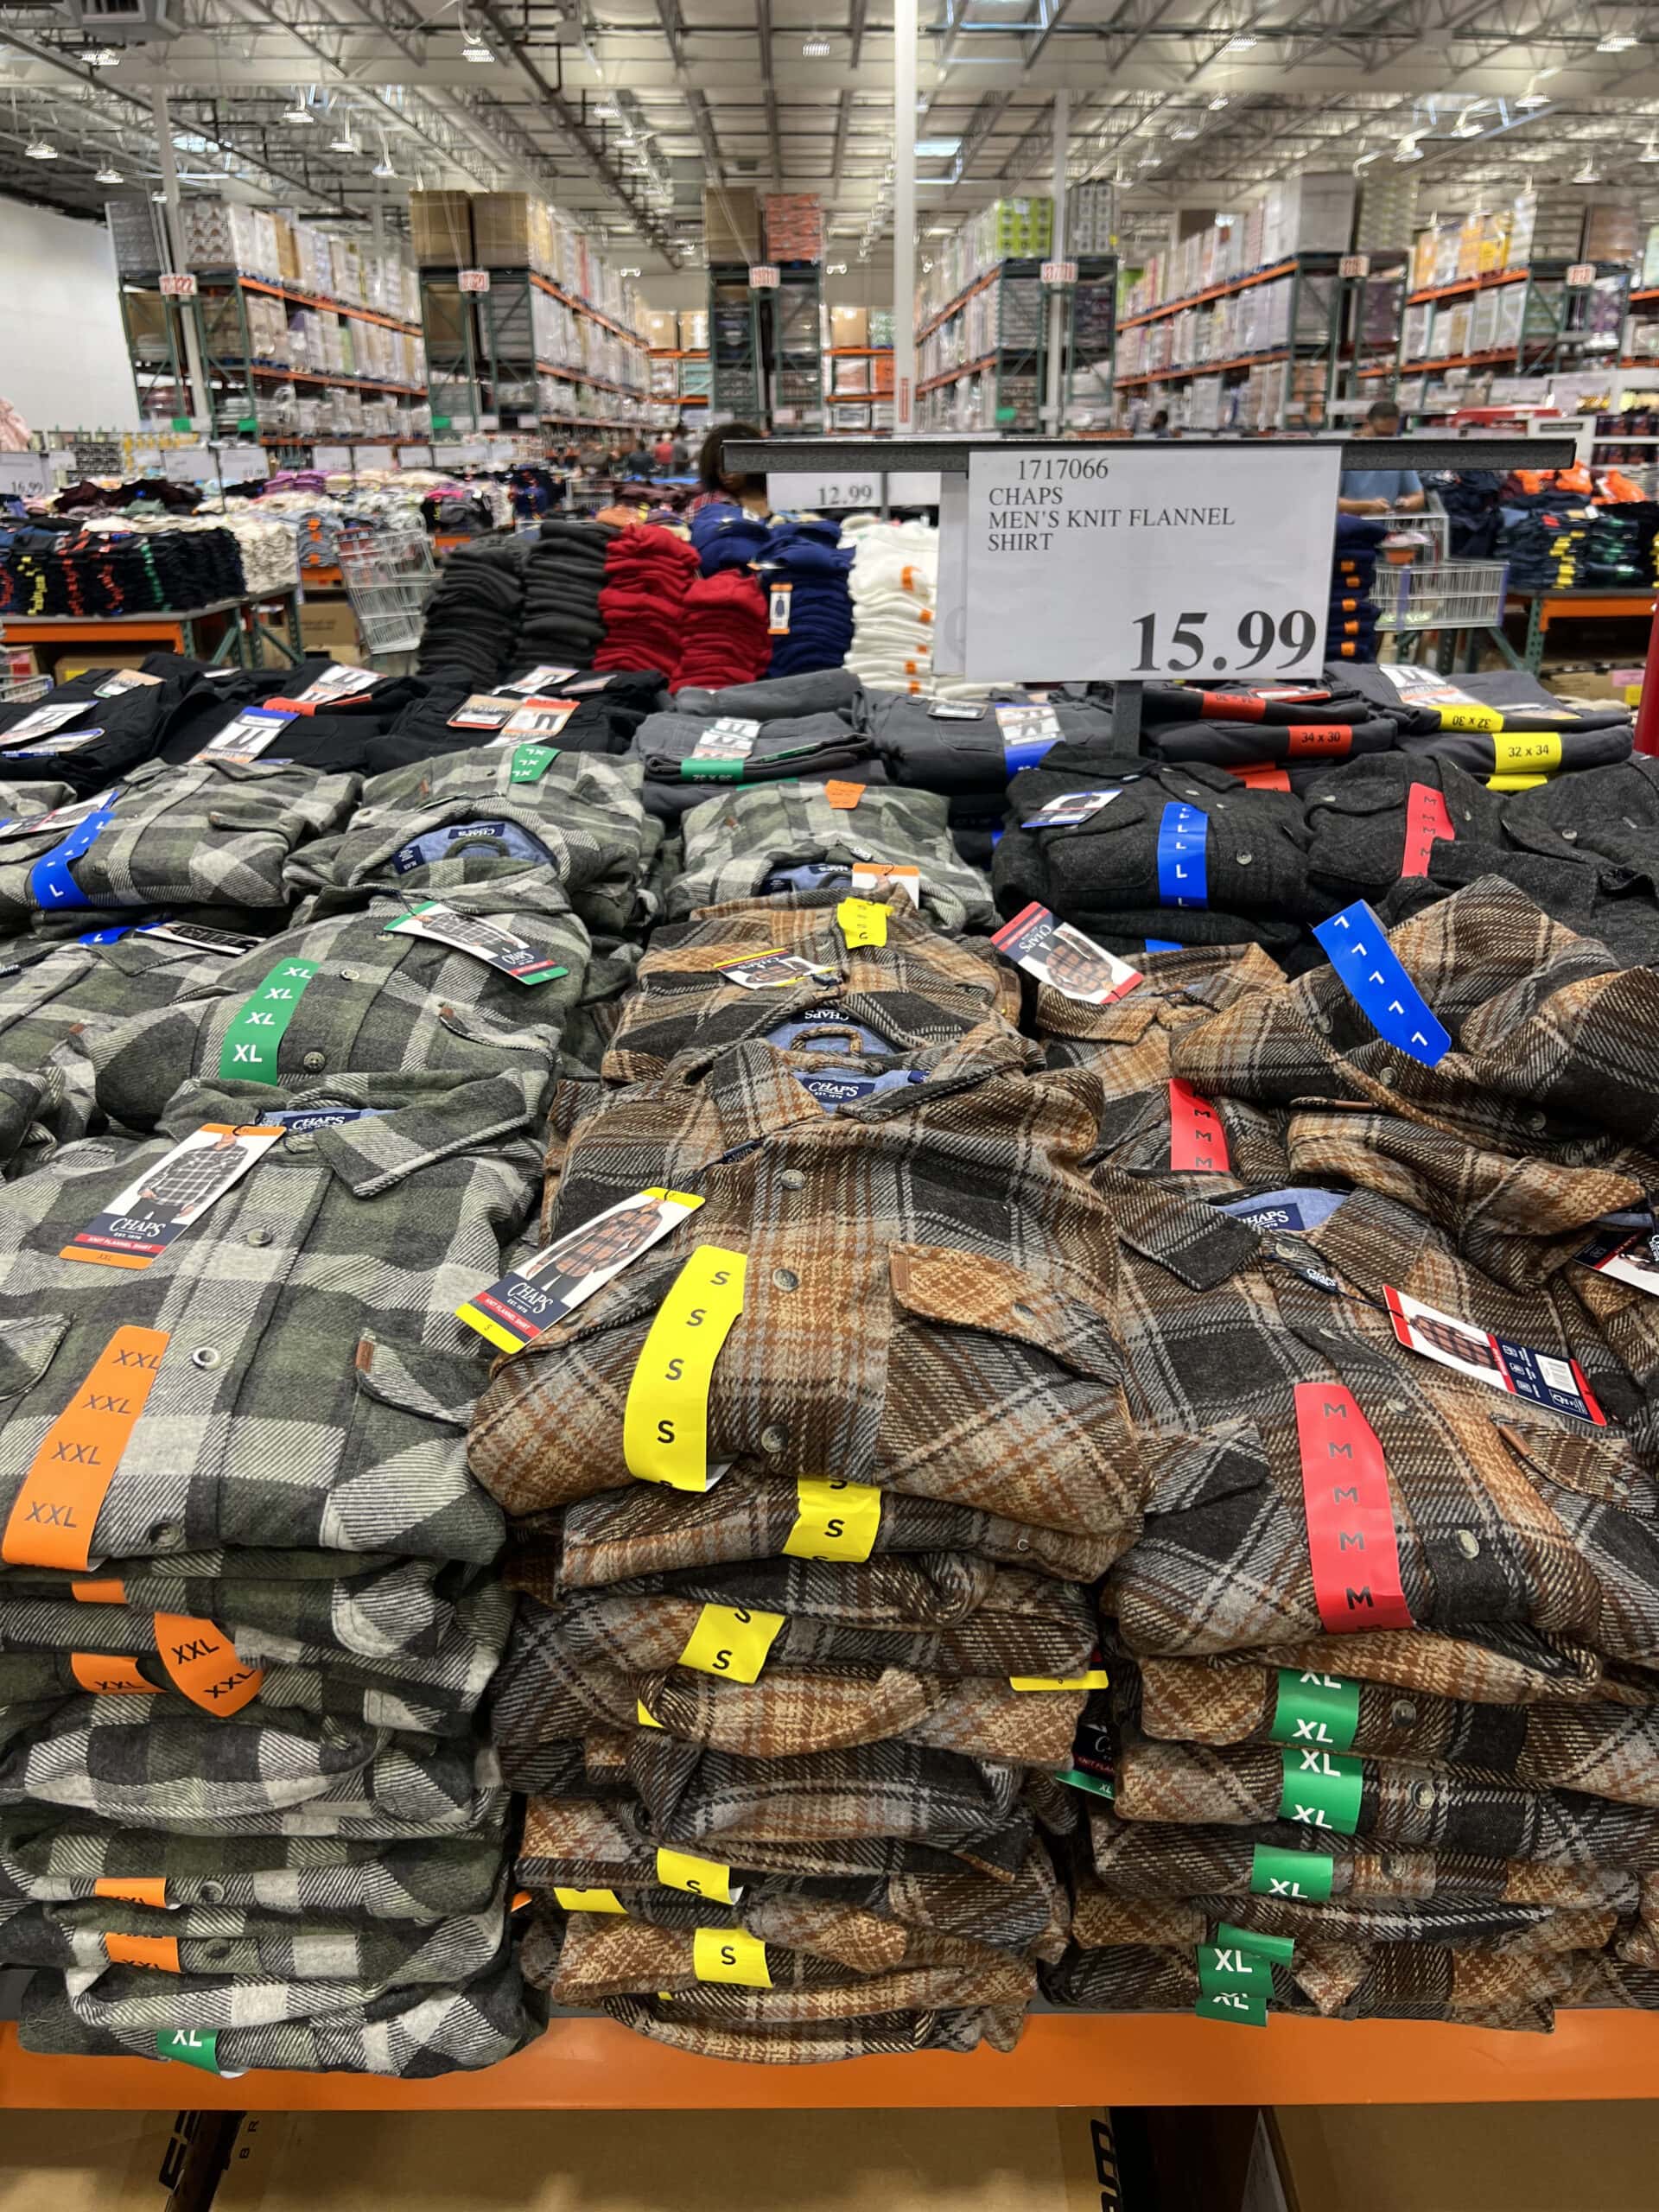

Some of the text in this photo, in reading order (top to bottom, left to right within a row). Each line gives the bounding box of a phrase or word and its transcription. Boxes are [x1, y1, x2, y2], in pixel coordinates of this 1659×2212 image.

[1018, 458, 1109, 480] 1717066
[818, 486, 872, 505] 12.99
[988, 486, 1064, 505] CHAPS
[988, 507, 1236, 530] MEN'S KNIT FLANNEL
[988, 532, 1053, 551] SHIRT
[1130, 609, 1316, 672] 15.99
[1452, 715, 1465, 727] 30
[1478, 719, 1491, 729] 32
[1301, 732, 1314, 743] 34
[1327, 732, 1340, 743] 30
[1508, 747, 1522, 758] 32
[1535, 745, 1549, 755] 34
[1177, 823, 1188, 833] L
[1176, 864, 1188, 879] L
[49, 884, 64, 898] L
[1178, 897, 1190, 906] L
[1333, 915, 1350, 929] L
[1351, 943, 1367, 957] L
[283, 966, 313, 979] XL
[1369, 970, 1385, 984] L
[264, 988, 294, 1000] XL
[1389, 1000, 1405, 1014] L
[245, 1012, 276, 1026] XL
[1411, 1032, 1428, 1046] L
[232, 1044, 263, 1063] XL
[808, 1081, 859, 1097] CHAPS
[292, 1116, 346, 1130] CHAPS
[1193, 1109, 1211, 1118] M
[1195, 1129, 1212, 1142] M
[1195, 1156, 1213, 1168] M
[109, 1217, 167, 1237] CHAPS
[1243, 1211, 1289, 1225] HAPS
[710, 1270, 731, 1286] S
[507, 1281, 554, 1313] CHAPS
[685, 1308, 708, 1327] S
[111, 1348, 161, 1371] XXL
[664, 1357, 685, 1381] S
[82, 1394, 132, 1414] XXL
[1324, 1402, 1347, 1419] M
[657, 1420, 677, 1444] S
[51, 1440, 102, 1466] XXL
[1328, 1442, 1353, 1459] M
[1333, 1486, 1359, 1505] M
[24, 1501, 78, 1529] XXL
[823, 1518, 846, 1538] S
[1339, 1531, 1366, 1551] M
[1345, 1586, 1376, 1610] M
[171, 1638, 220, 1665] XXL
[712, 1649, 733, 1670] S
[94, 1679, 146, 1691] XXL
[203, 1669, 257, 1700] XXL
[1300, 1671, 1343, 1689] XL
[1292, 1718, 1335, 1745] XL
[1300, 1749, 1341, 1777] XL
[1098, 1783, 1112, 1795] XL
[1292, 1803, 1333, 1829] XL
[685, 1878, 703, 1895] S
[1268, 1877, 1308, 1898] XL
[720, 1944, 737, 1966] S
[1214, 1948, 1253, 1974] XL
[1212, 1992, 1249, 2011] XL
[172, 2029, 203, 2048] XL
